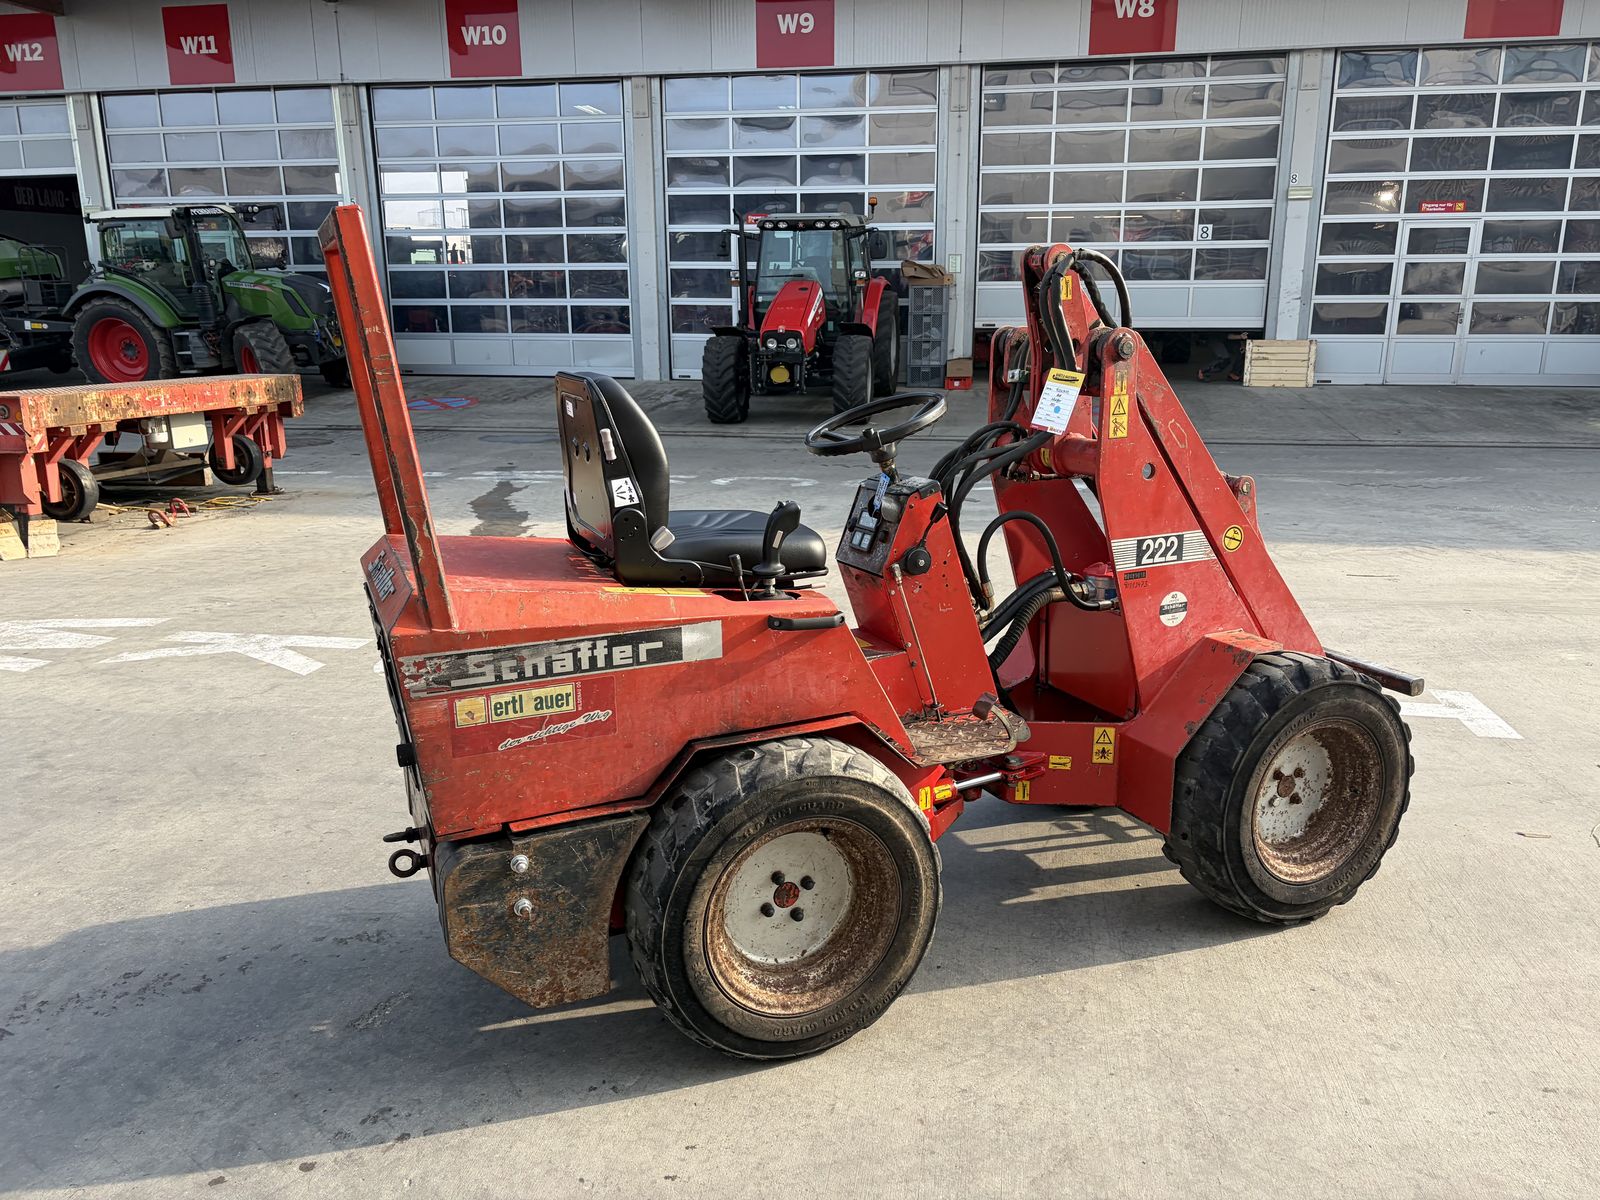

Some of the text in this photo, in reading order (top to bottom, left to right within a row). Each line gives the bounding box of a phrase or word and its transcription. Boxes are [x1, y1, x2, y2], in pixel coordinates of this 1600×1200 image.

[1113, 0, 1155, 19] W8
[776, 12, 815, 34] W9
[179, 35, 218, 55] W11
[460, 24, 507, 46] W10
[4, 42, 44, 62] W12
[1290, 173, 1298, 184] 8
[1199, 225, 1209, 239] 8
[1141, 536, 1179, 565] 222
[493, 690, 572, 717] ertl auer
[526, 720, 577, 744] richtige
